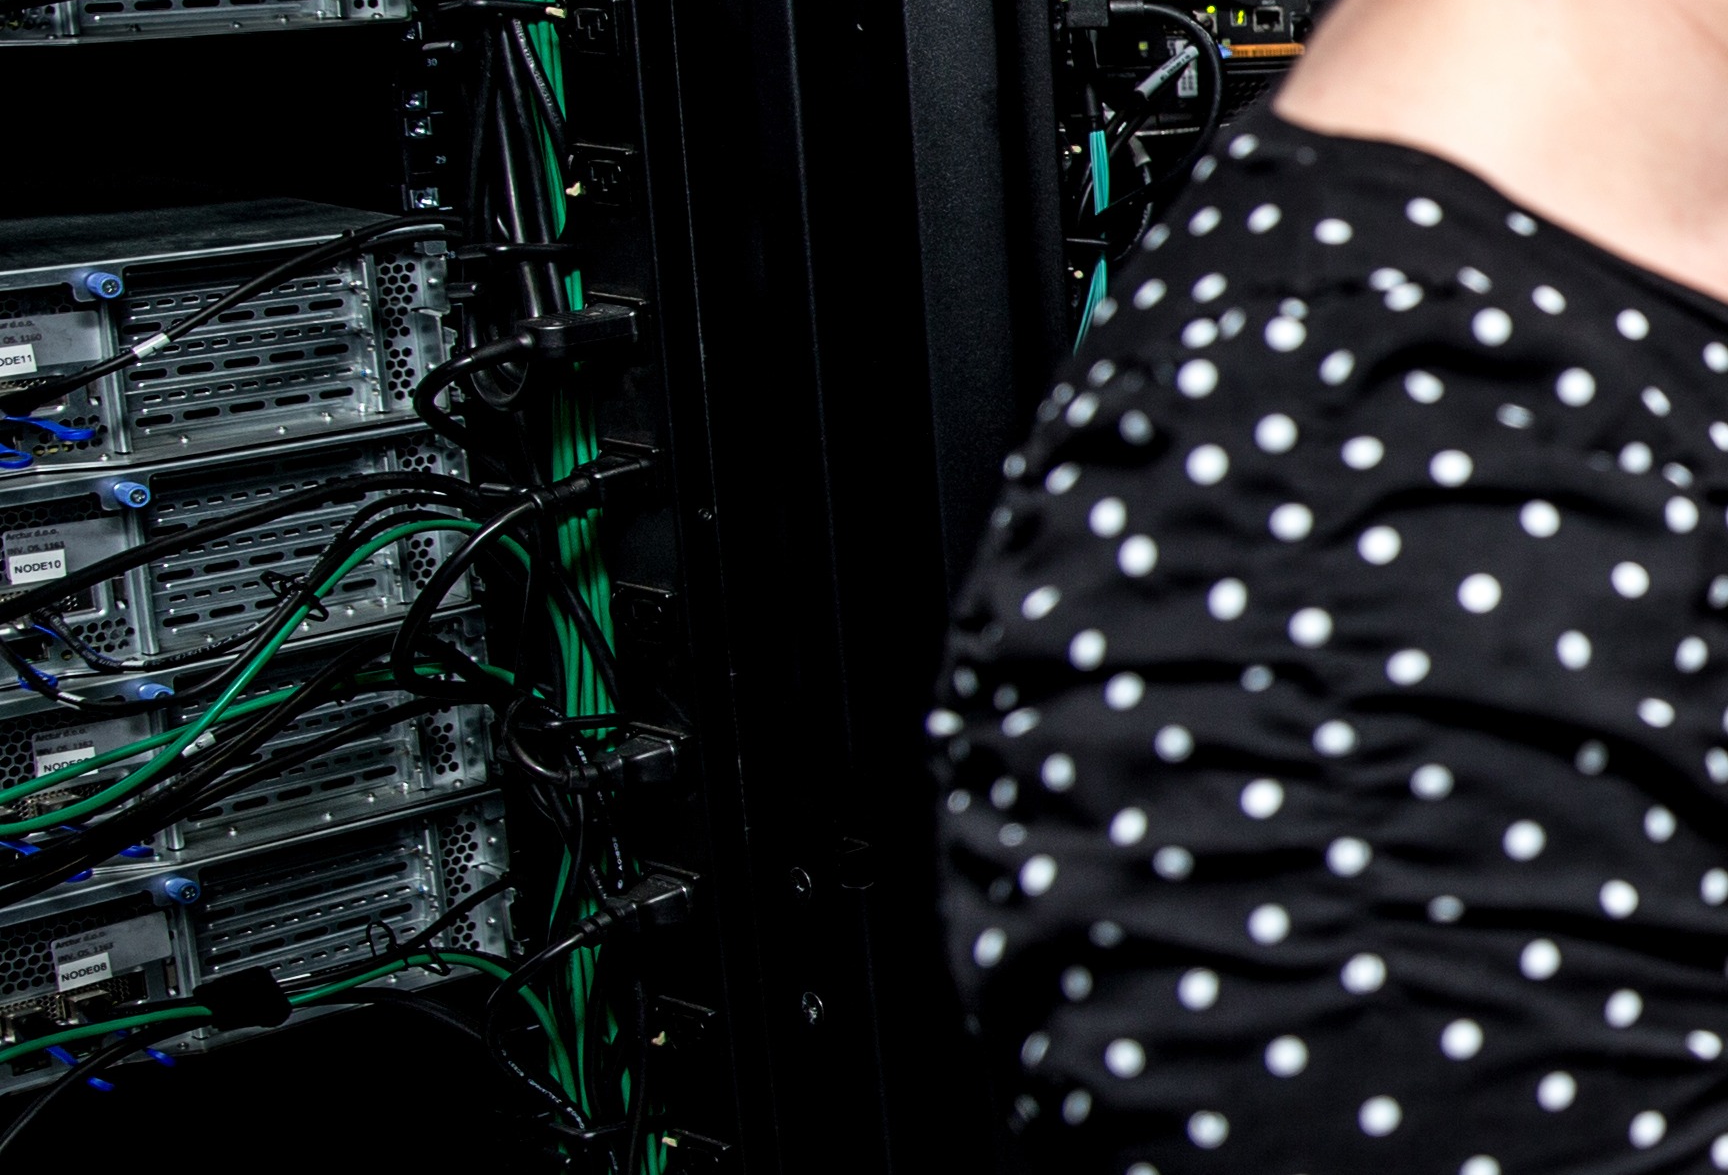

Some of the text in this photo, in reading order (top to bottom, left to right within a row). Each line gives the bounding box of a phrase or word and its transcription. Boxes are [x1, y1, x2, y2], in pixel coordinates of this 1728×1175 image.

[426, 57, 438, 68] 30
[14, 559, 62, 574] NODE10
[61, 961, 108, 983] NODE08
